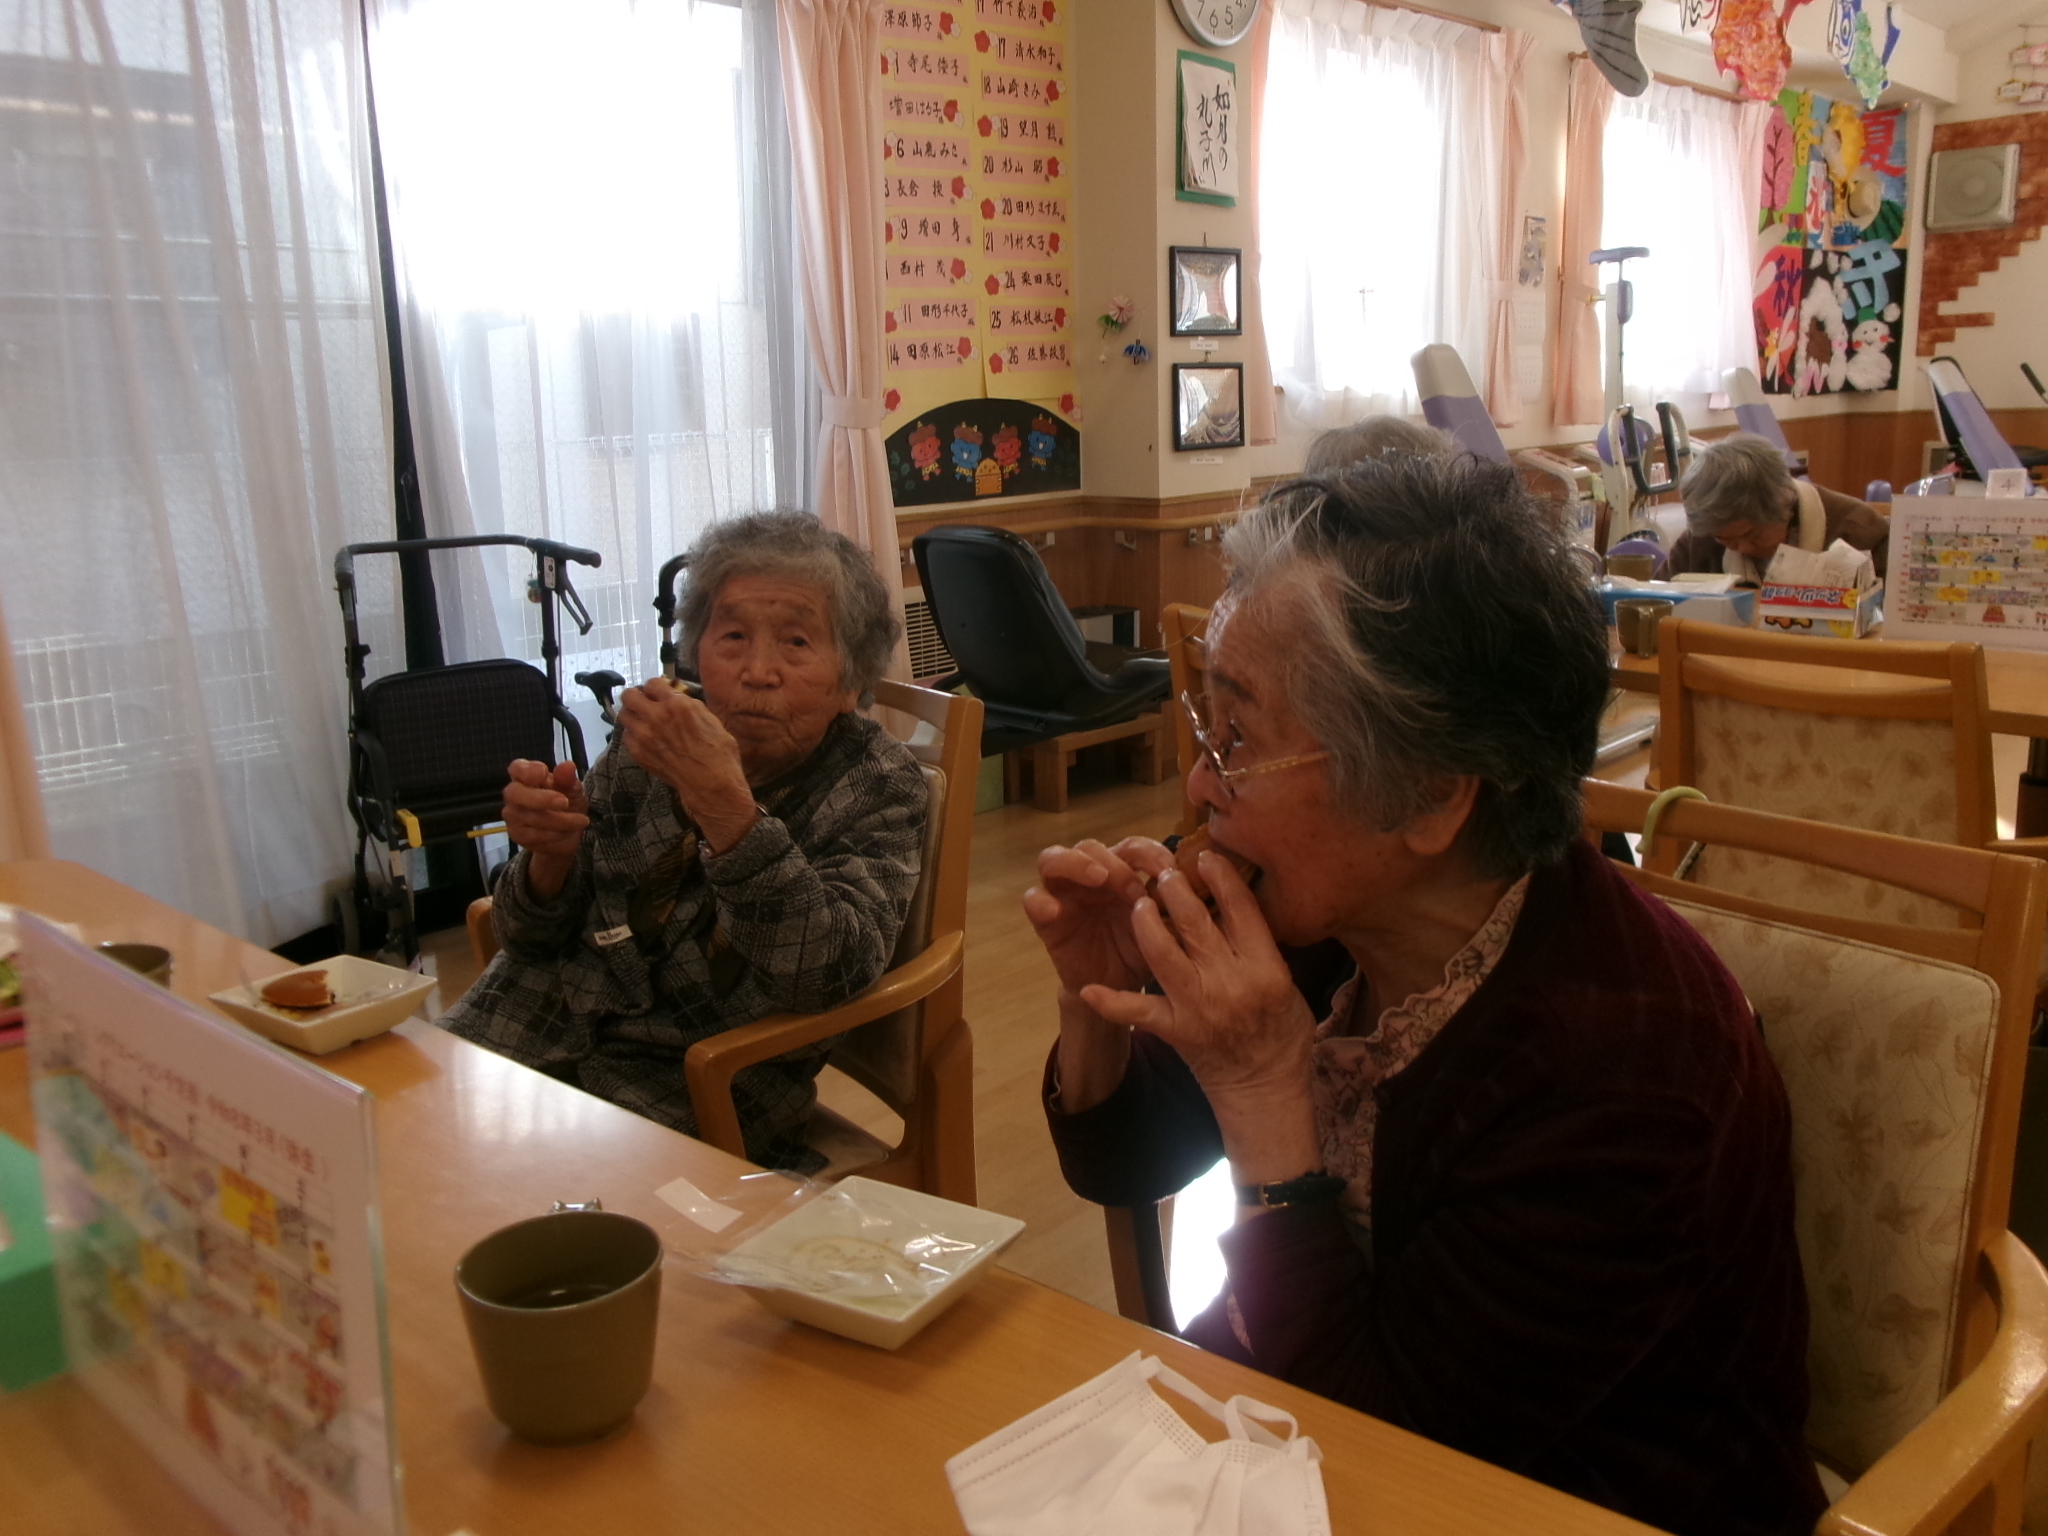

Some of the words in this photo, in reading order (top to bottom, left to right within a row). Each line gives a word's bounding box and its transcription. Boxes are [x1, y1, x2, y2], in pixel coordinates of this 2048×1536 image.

[1209, 9, 1219, 29] 6
[1224, 5, 1234, 26] 5
[983, 75, 992, 95] 18
[1000, 117, 1009, 139] 19
[896, 138, 905, 159] 6
[1860, 107, 1908, 178] 夏
[983, 155, 995, 175] 20
[1001, 197, 1013, 216] 20
[900, 217, 908, 241] 9
[985, 231, 994, 253] 21
[1004, 270, 1016, 293] 24
[1774, 253, 1806, 318] 秋
[991, 310, 1002, 330] 25
[889, 343, 900, 367] 14
[1007, 345, 1019, 370] 26
